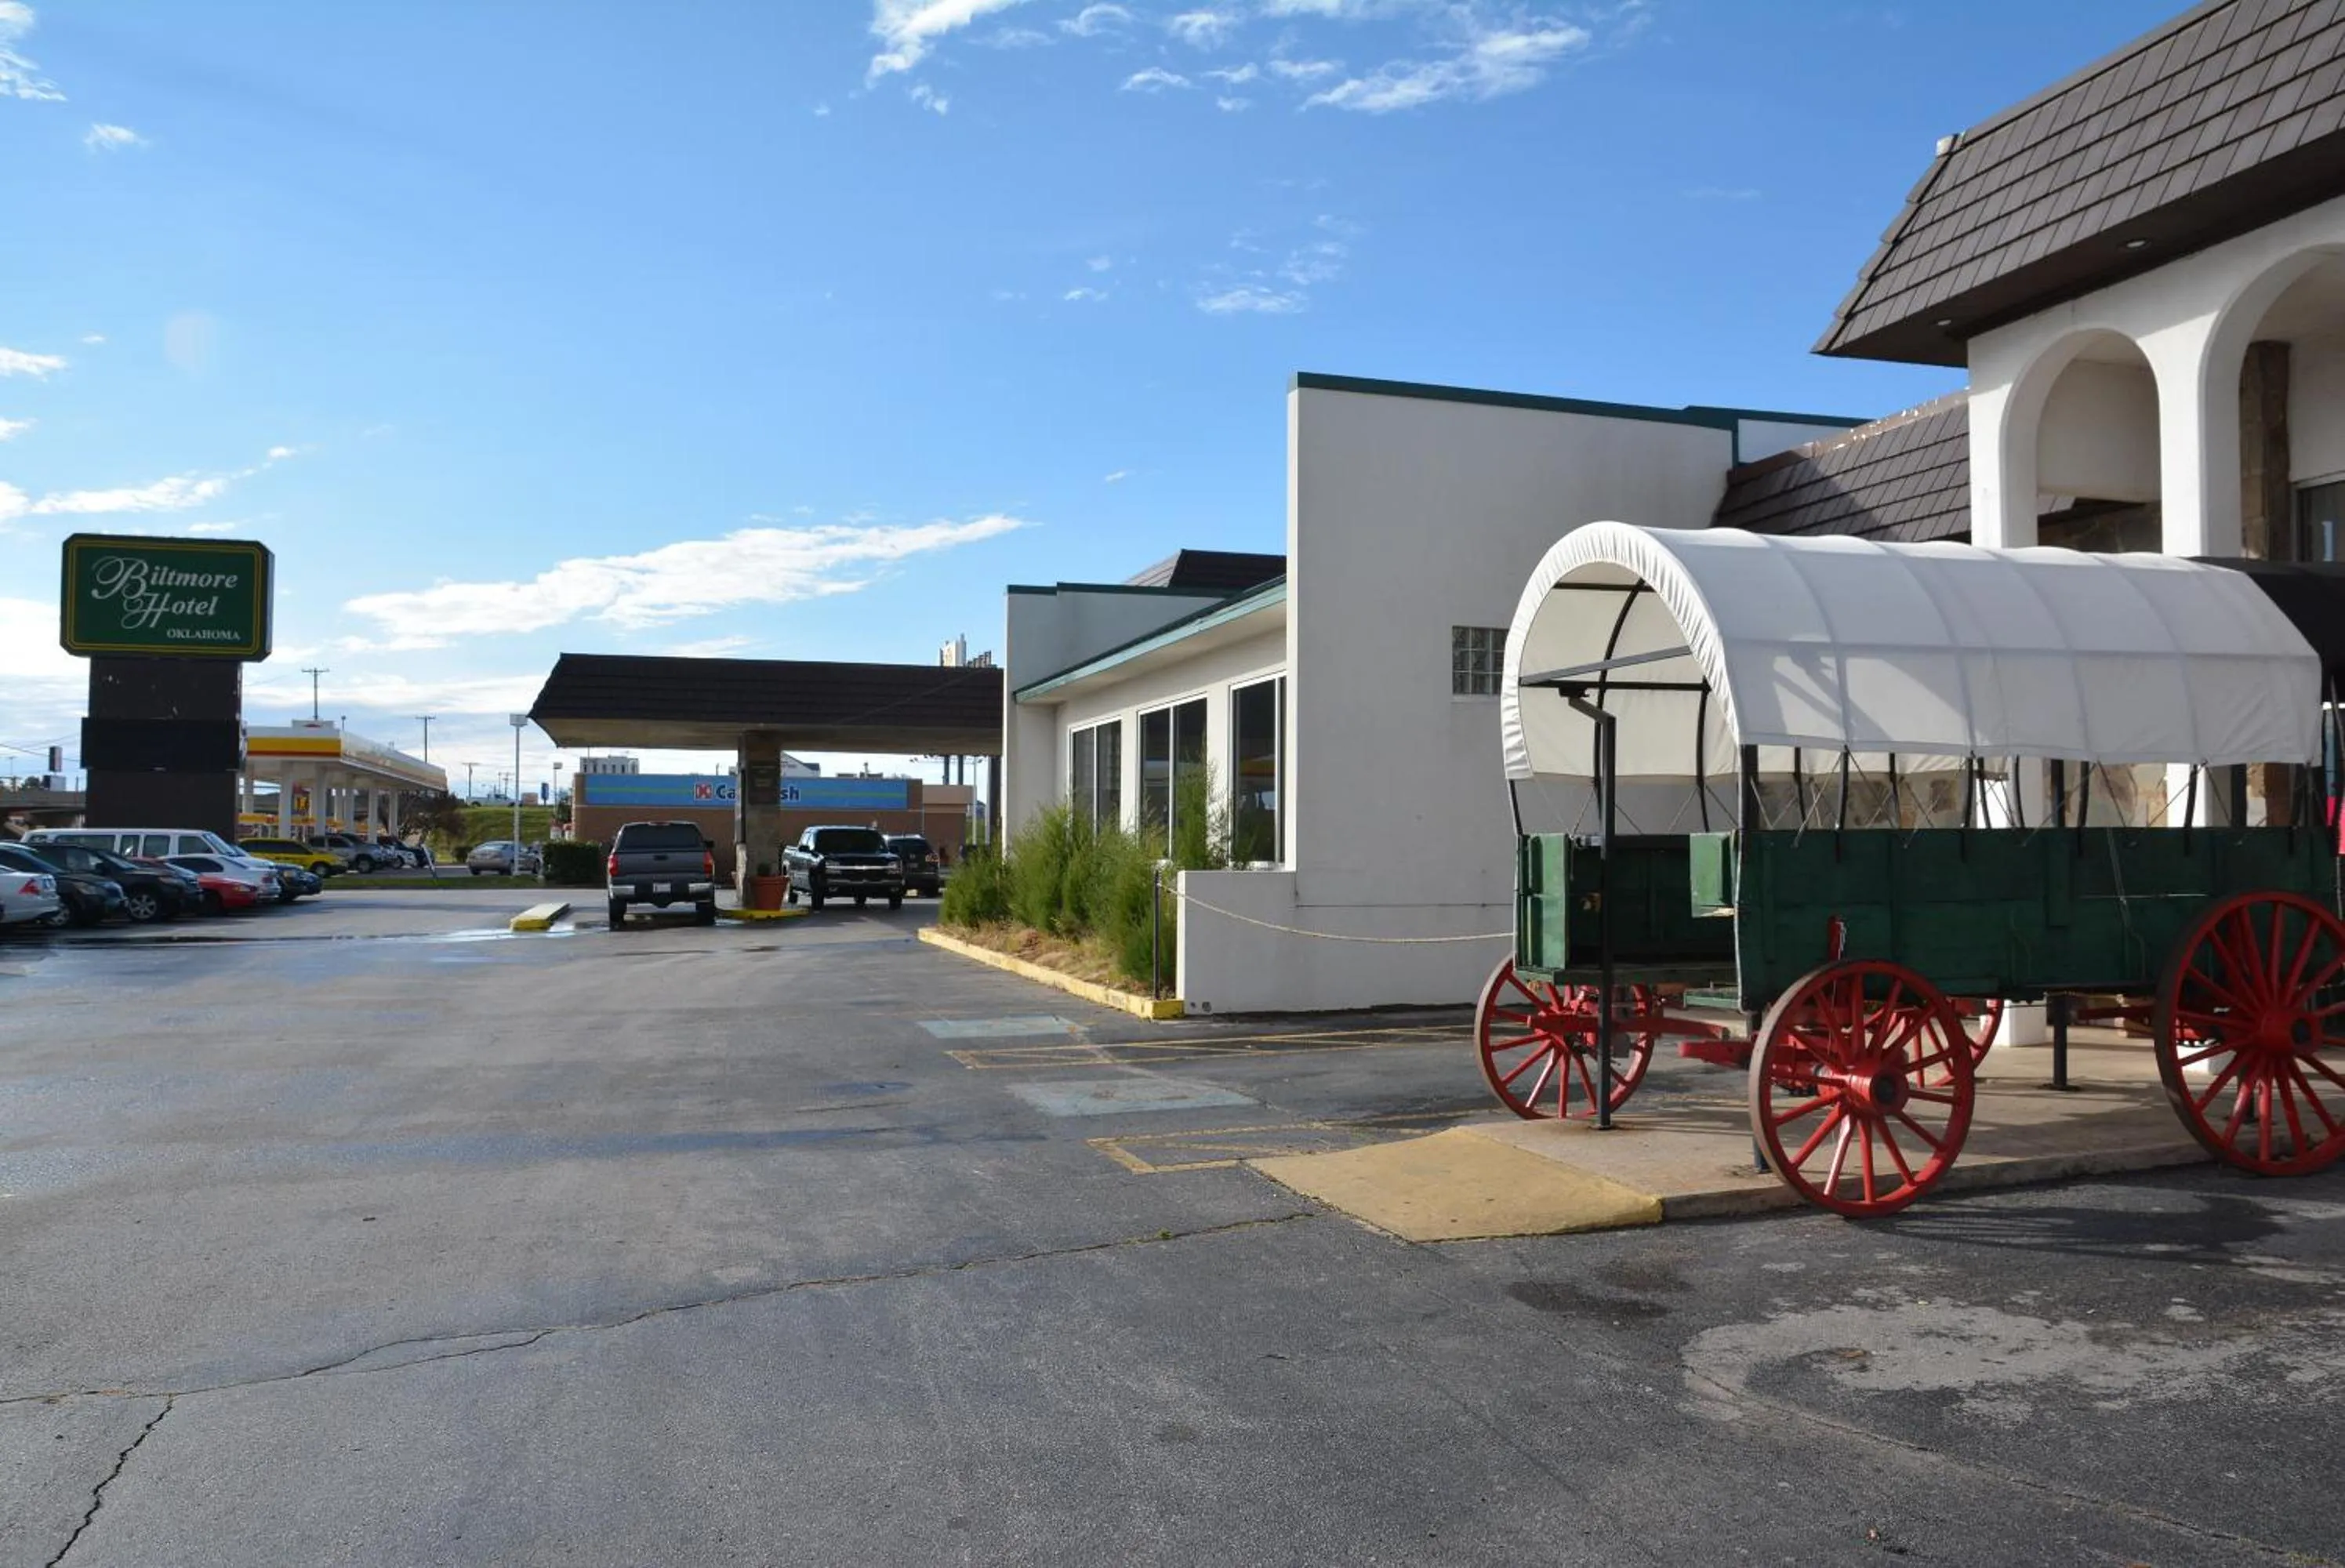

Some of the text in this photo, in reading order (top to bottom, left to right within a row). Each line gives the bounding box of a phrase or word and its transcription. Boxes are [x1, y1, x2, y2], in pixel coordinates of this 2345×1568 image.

[91, 555, 238, 600] Biltmore
[121, 592, 219, 630] Hotel
[166, 628, 241, 641] OKLAHOMA
